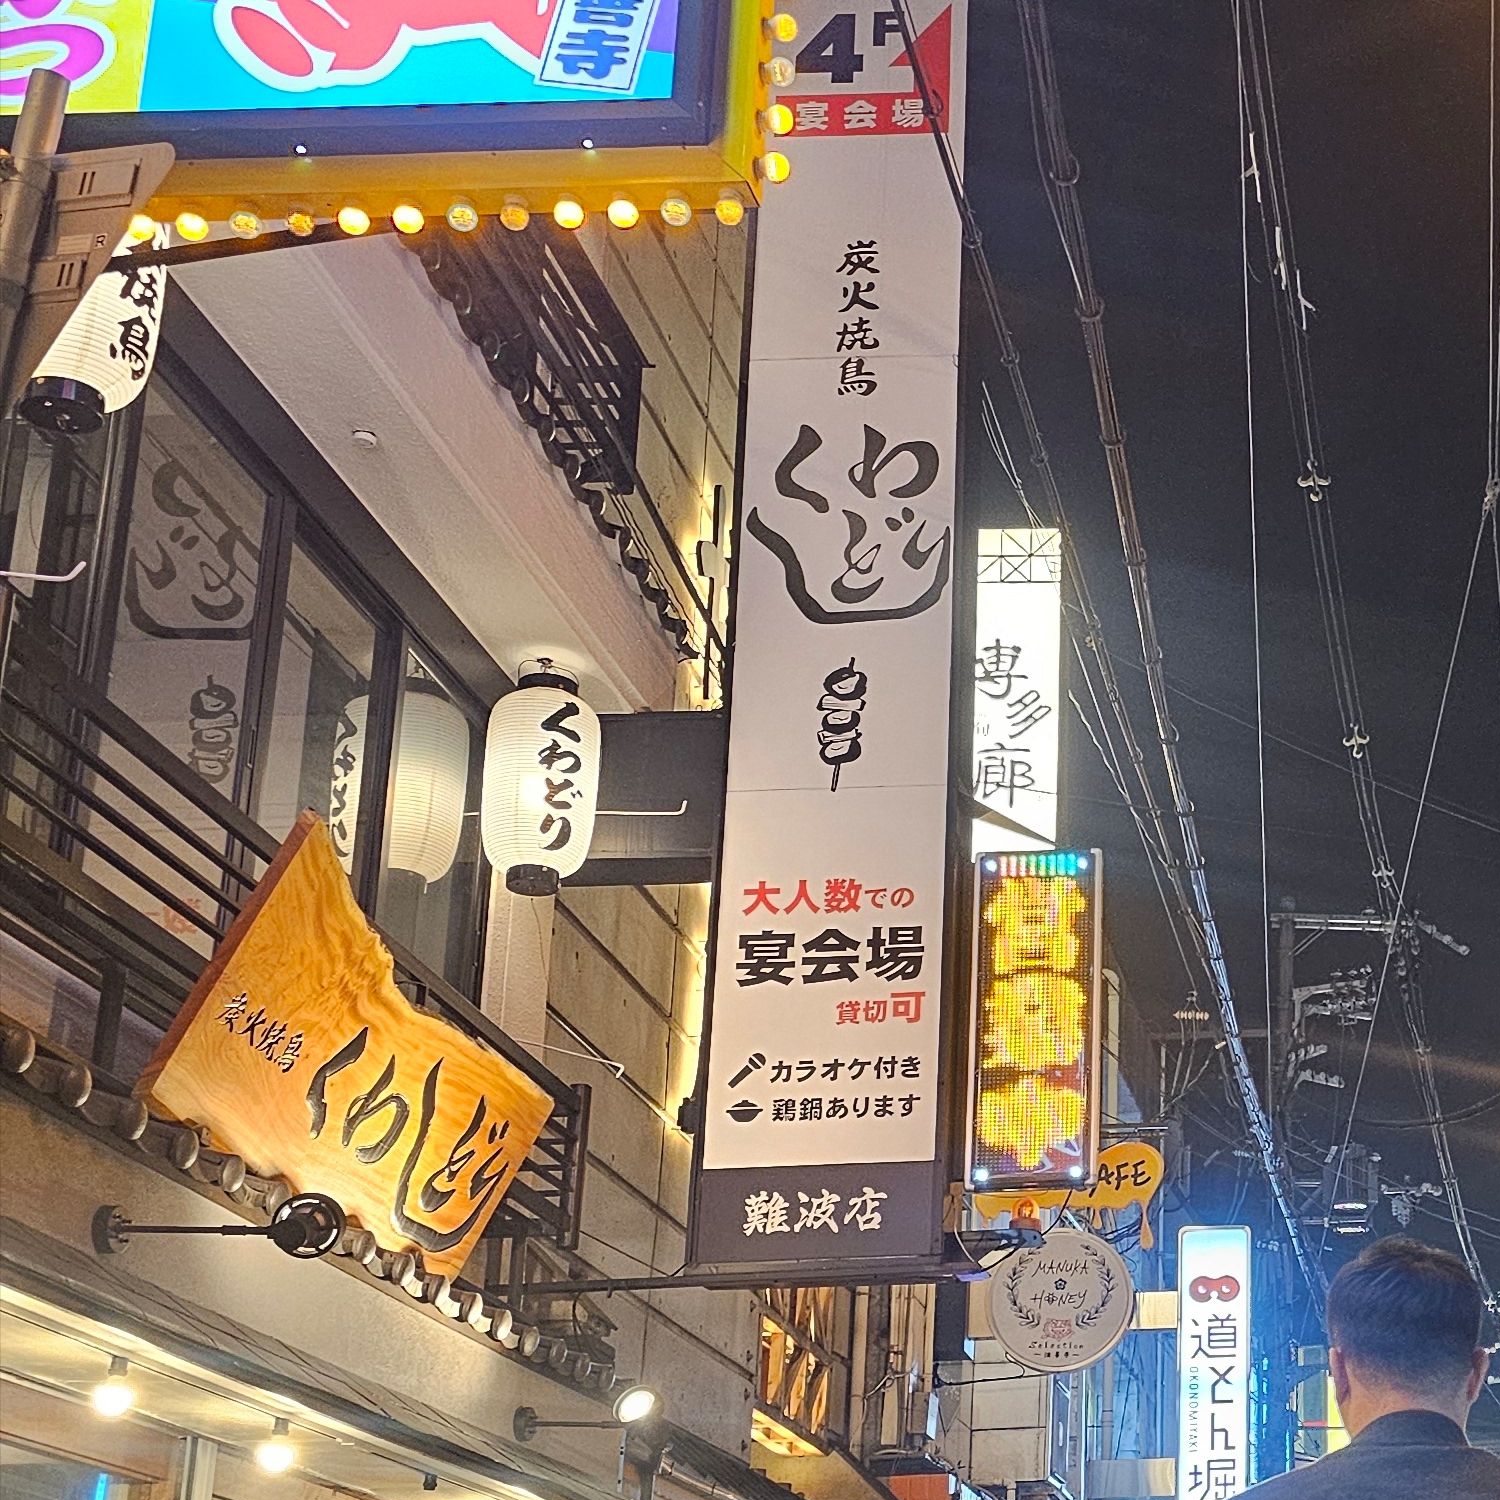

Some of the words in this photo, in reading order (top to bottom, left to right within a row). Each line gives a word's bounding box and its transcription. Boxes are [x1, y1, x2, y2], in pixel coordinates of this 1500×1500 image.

[795, 100, 928, 131] 宴会場
[835, 239, 881, 397] 炭火焼鳥
[538, 701, 583, 851] くわどり
[743, 878, 915, 915] 大人数での
[735, 926, 925, 988] 宴会場
[836, 990, 926, 1025] 貸切可
[216, 992, 304, 1073] 炭火焼鳥
[771, 1055, 922, 1083] カラオケ付き
[772, 1093, 921, 1122] 鶏鍋あります
[1089, 1159, 1152, 1199] AFE
[742, 1187, 888, 1236] 難波店
[1031, 1258, 1090, 1278] MANUKA
[1188, 1366, 1199, 1453] OKONOMIYAKI
